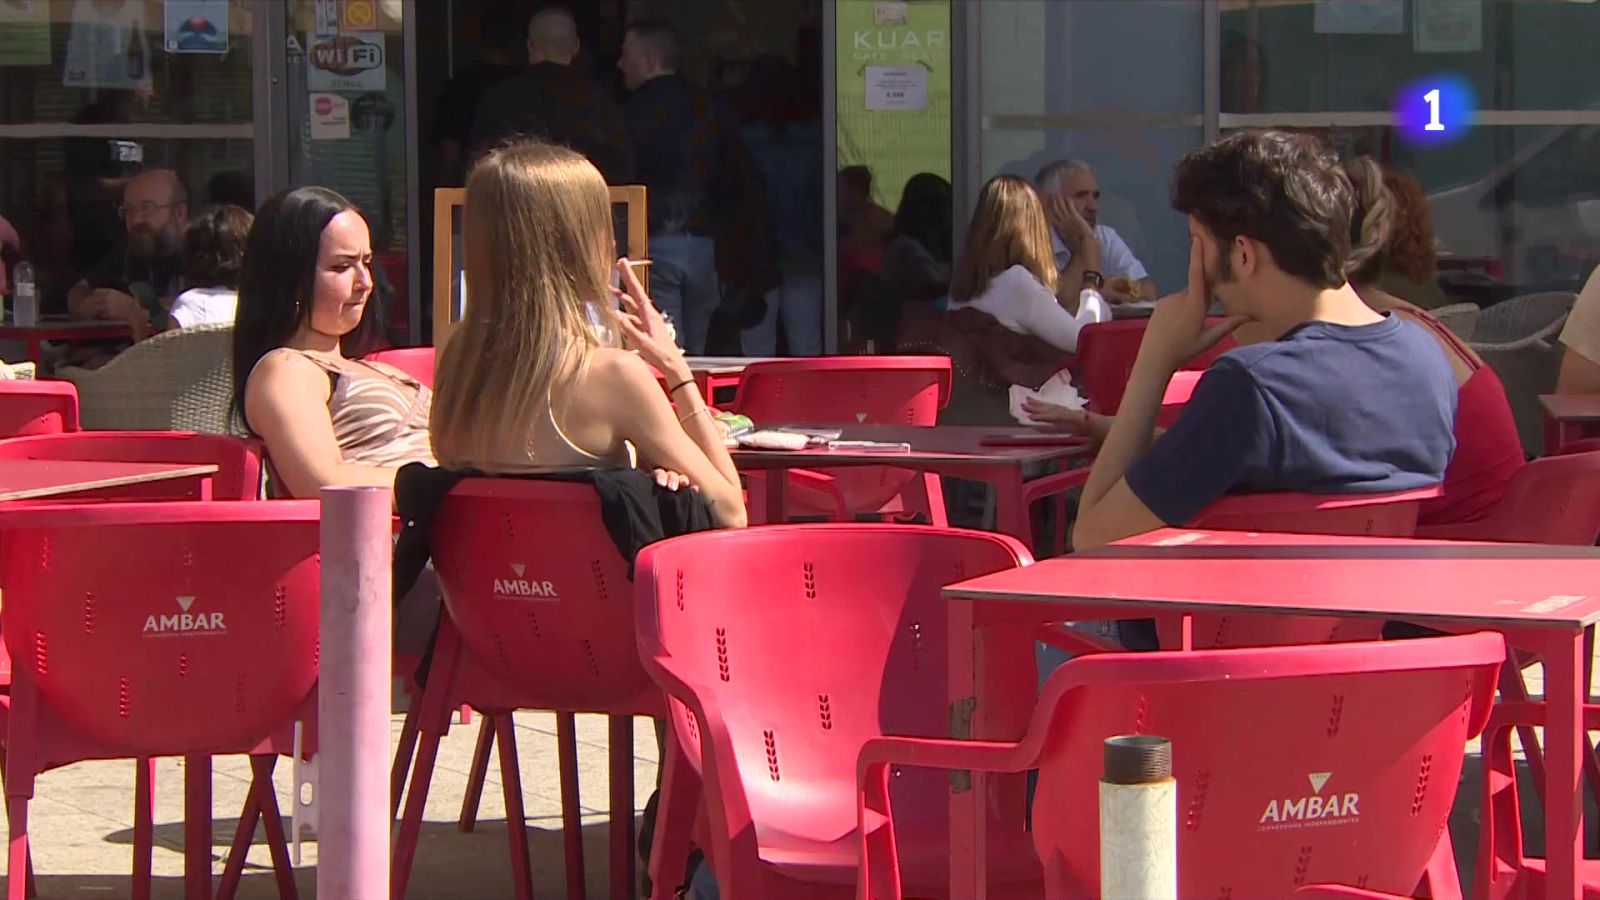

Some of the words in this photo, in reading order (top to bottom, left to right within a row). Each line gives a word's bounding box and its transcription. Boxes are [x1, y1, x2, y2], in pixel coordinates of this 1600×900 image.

[493, 579, 558, 597] AMBAR
[143, 612, 226, 632] AMBAR
[1259, 792, 1360, 824] AMBAR
